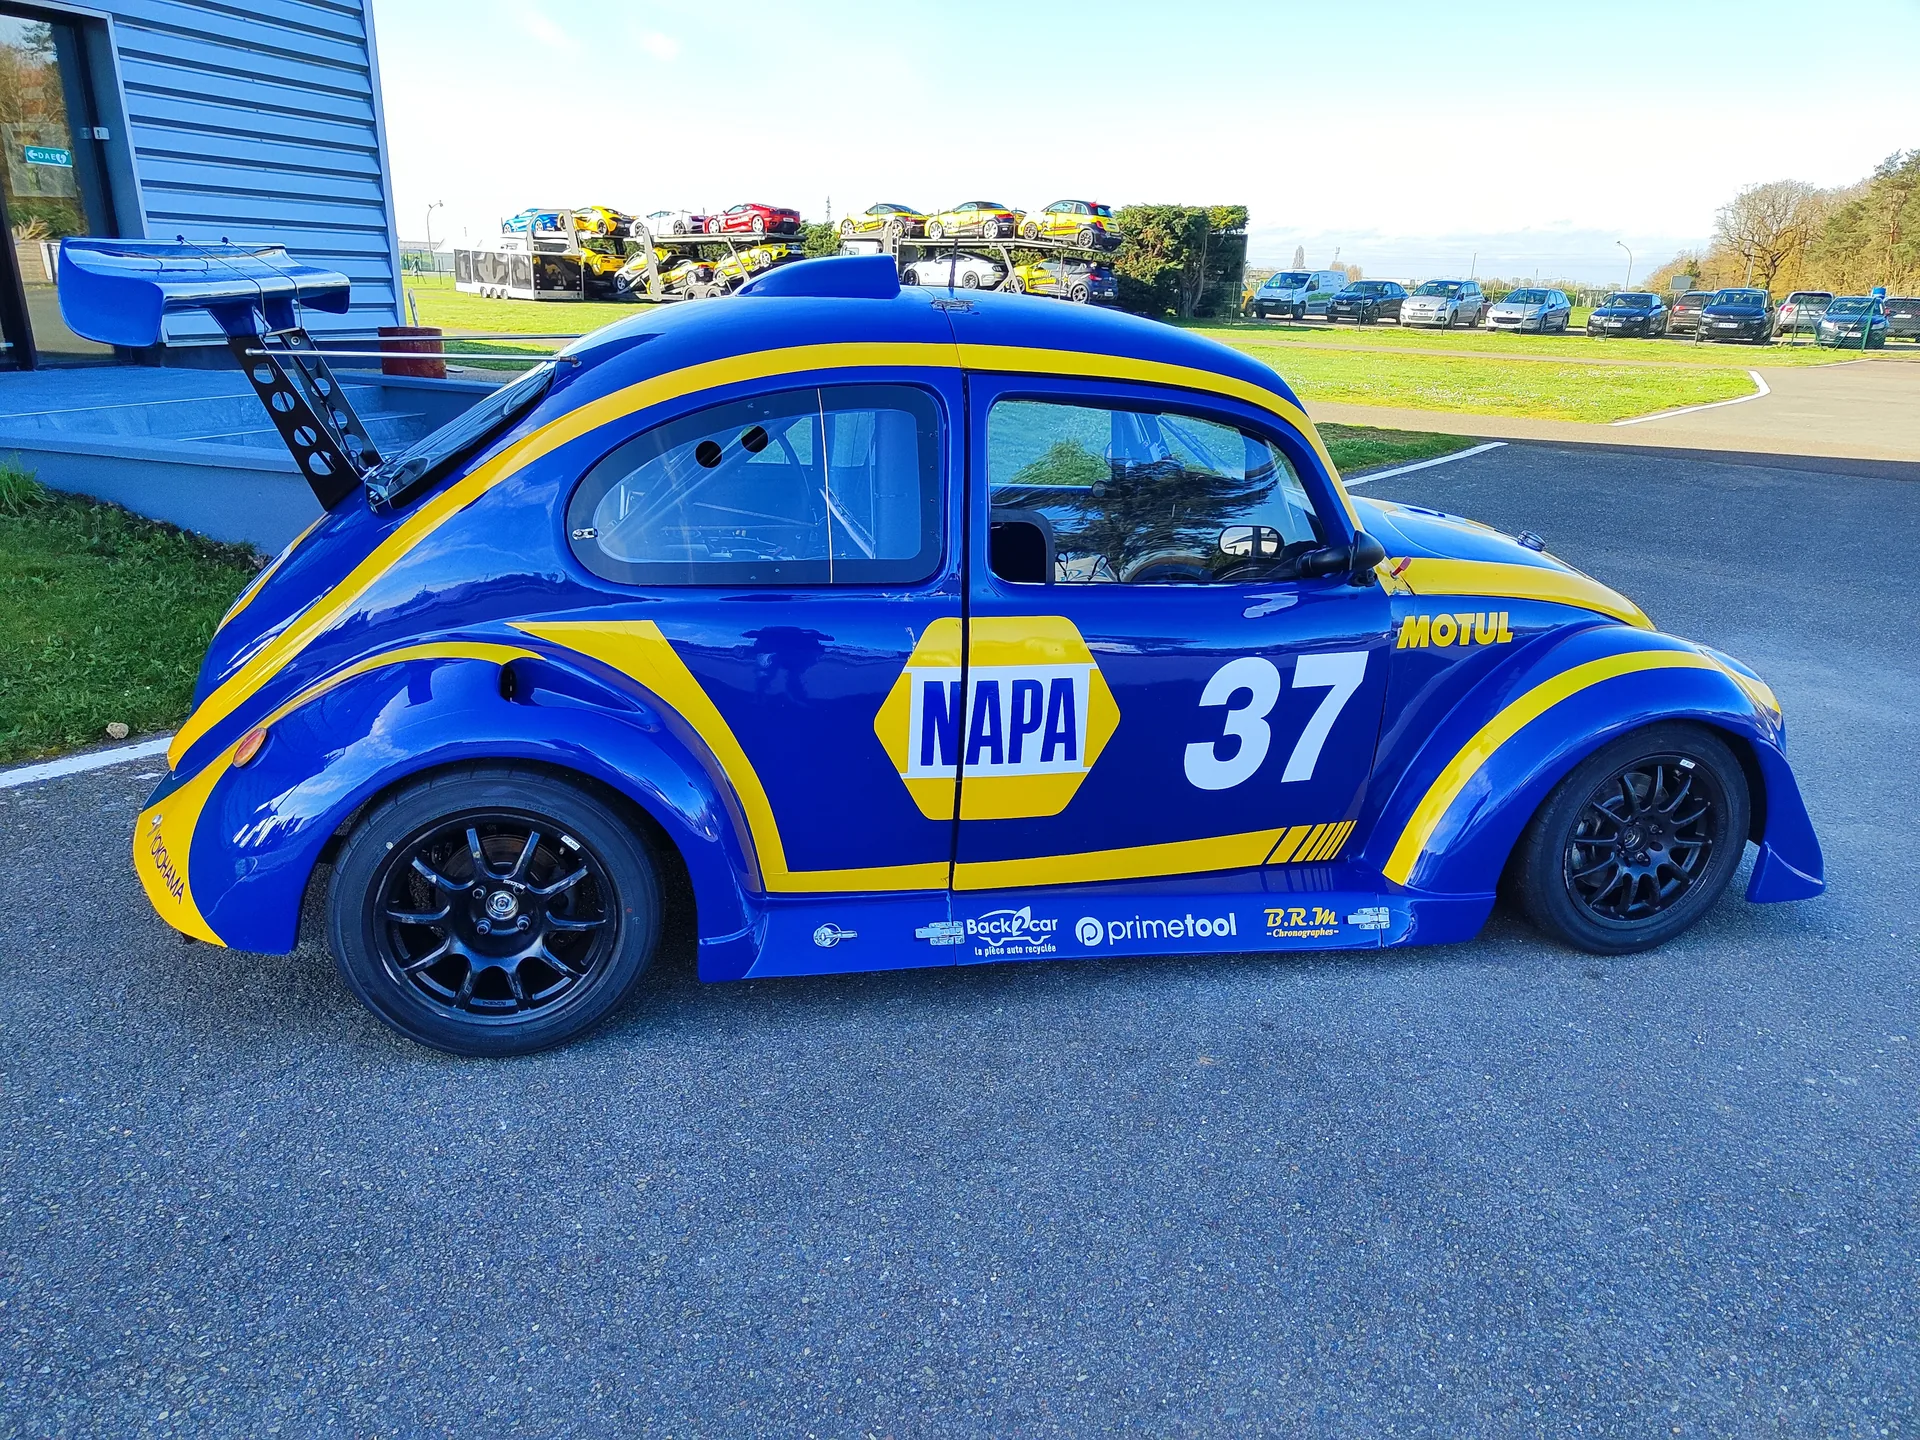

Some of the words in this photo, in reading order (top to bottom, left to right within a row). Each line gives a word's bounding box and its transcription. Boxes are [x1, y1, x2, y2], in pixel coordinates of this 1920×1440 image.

[38, 152, 56, 160] DAE
[1396, 612, 1513, 649] MOTUL
[920, 676, 1078, 767] NAPA
[1184, 651, 1369, 790] 37
[149, 829, 185, 905] YOKOHAMA
[966, 914, 1058, 936] Back2car
[1107, 912, 1237, 946] primetool
[974, 946, 983, 956] la
[984, 945, 1005, 957] pièce
[1006, 945, 1023, 955] auto
[1025, 943, 1057, 955] recyclée
